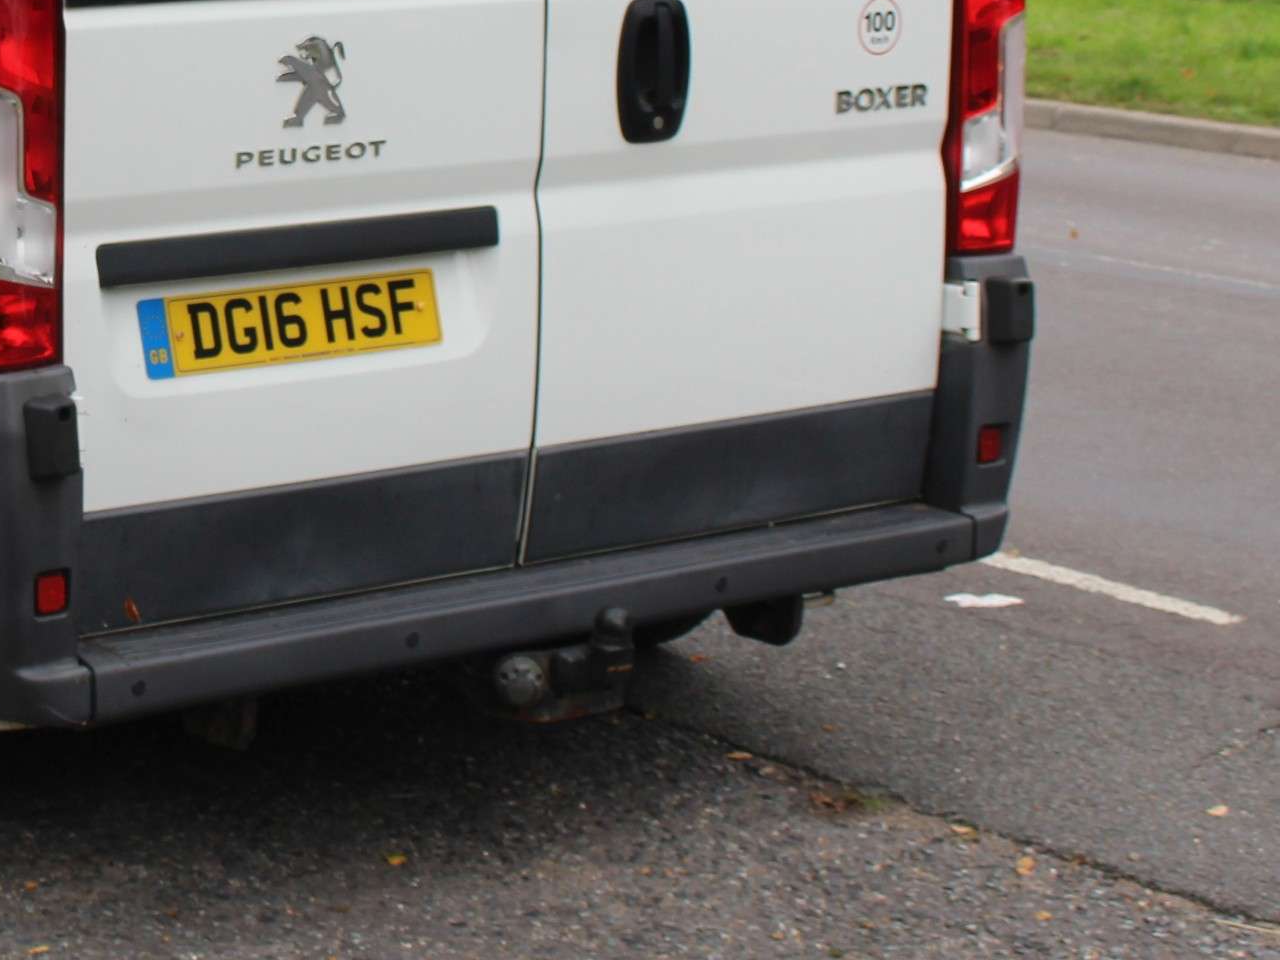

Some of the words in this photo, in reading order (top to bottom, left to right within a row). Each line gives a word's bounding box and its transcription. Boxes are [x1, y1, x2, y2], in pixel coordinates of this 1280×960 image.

[864, 11, 895, 32] 100
[835, 84, 928, 114] BOXER
[235, 140, 387, 169] PEUGEOT
[186, 291, 307, 361] DG16
[319, 278, 416, 344] HSF
[149, 347, 168, 365] GB
